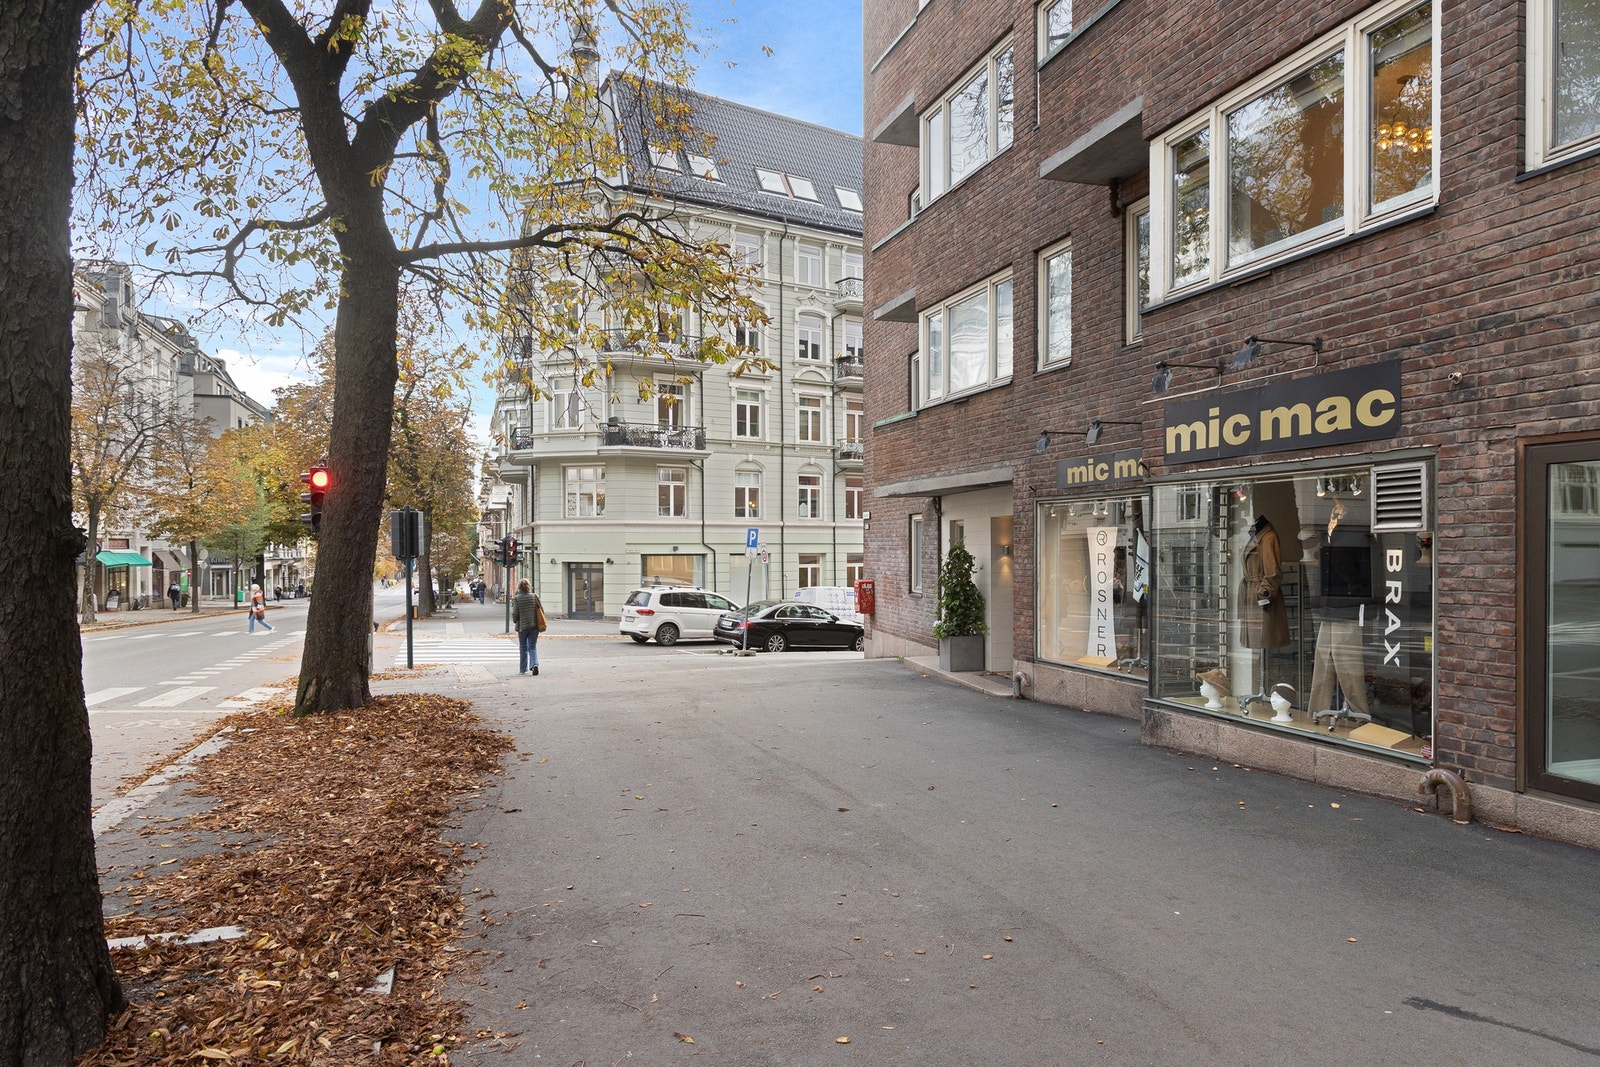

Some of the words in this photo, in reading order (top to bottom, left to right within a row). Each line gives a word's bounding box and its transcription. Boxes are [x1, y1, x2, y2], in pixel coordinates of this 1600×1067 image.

[1165, 406, 1251, 454] mic
[1260, 389, 1396, 441] mac
[1067, 458, 1109, 484] mic
[749, 530, 757, 546] P
[1097, 553, 1107, 657] ROSNER
[1383, 549, 1402, 668] BRAX
